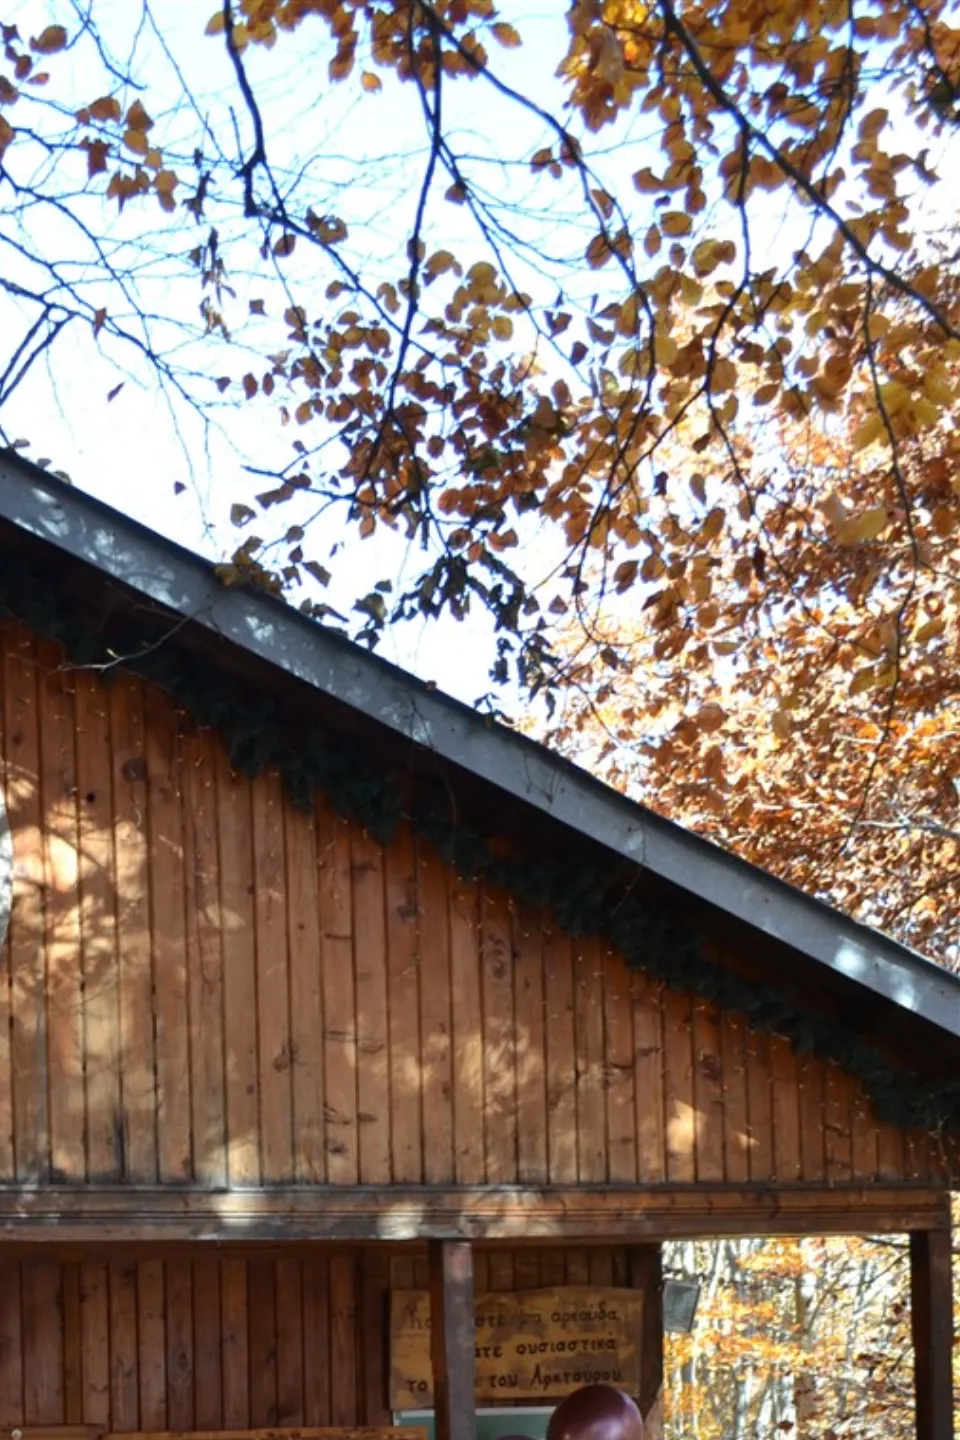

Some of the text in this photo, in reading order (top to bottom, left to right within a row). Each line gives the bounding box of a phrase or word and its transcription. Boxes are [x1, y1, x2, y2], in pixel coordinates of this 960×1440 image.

[516, 1331, 617, 1355] ουσιαστικά
[405, 1363, 623, 1394] το του Αρκτούρου
